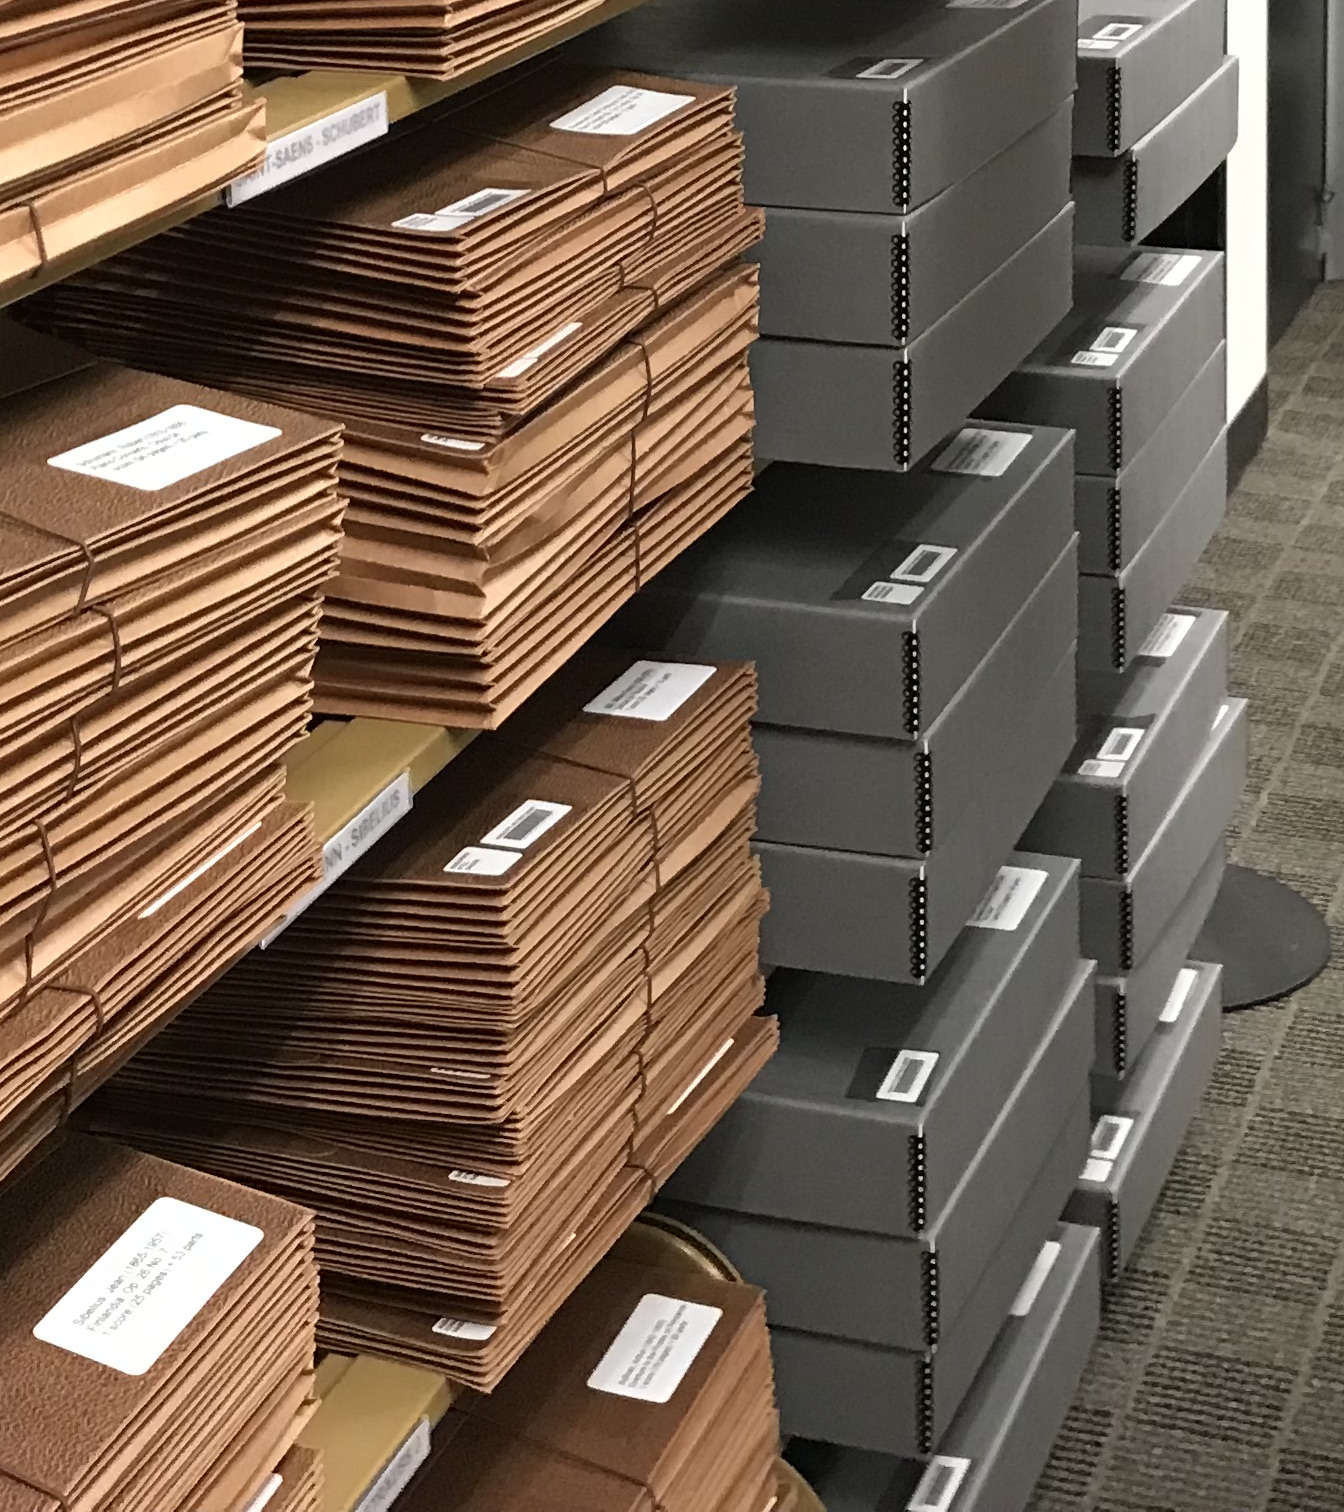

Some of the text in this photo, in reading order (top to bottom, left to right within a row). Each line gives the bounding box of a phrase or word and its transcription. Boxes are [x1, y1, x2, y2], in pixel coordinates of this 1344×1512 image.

[321, 103, 380, 146] SCHUBERT
[109, 1308, 133, 1330] score
[182, 1232, 204, 1251] parts
[87, 1297, 125, 1332] Finlandia
